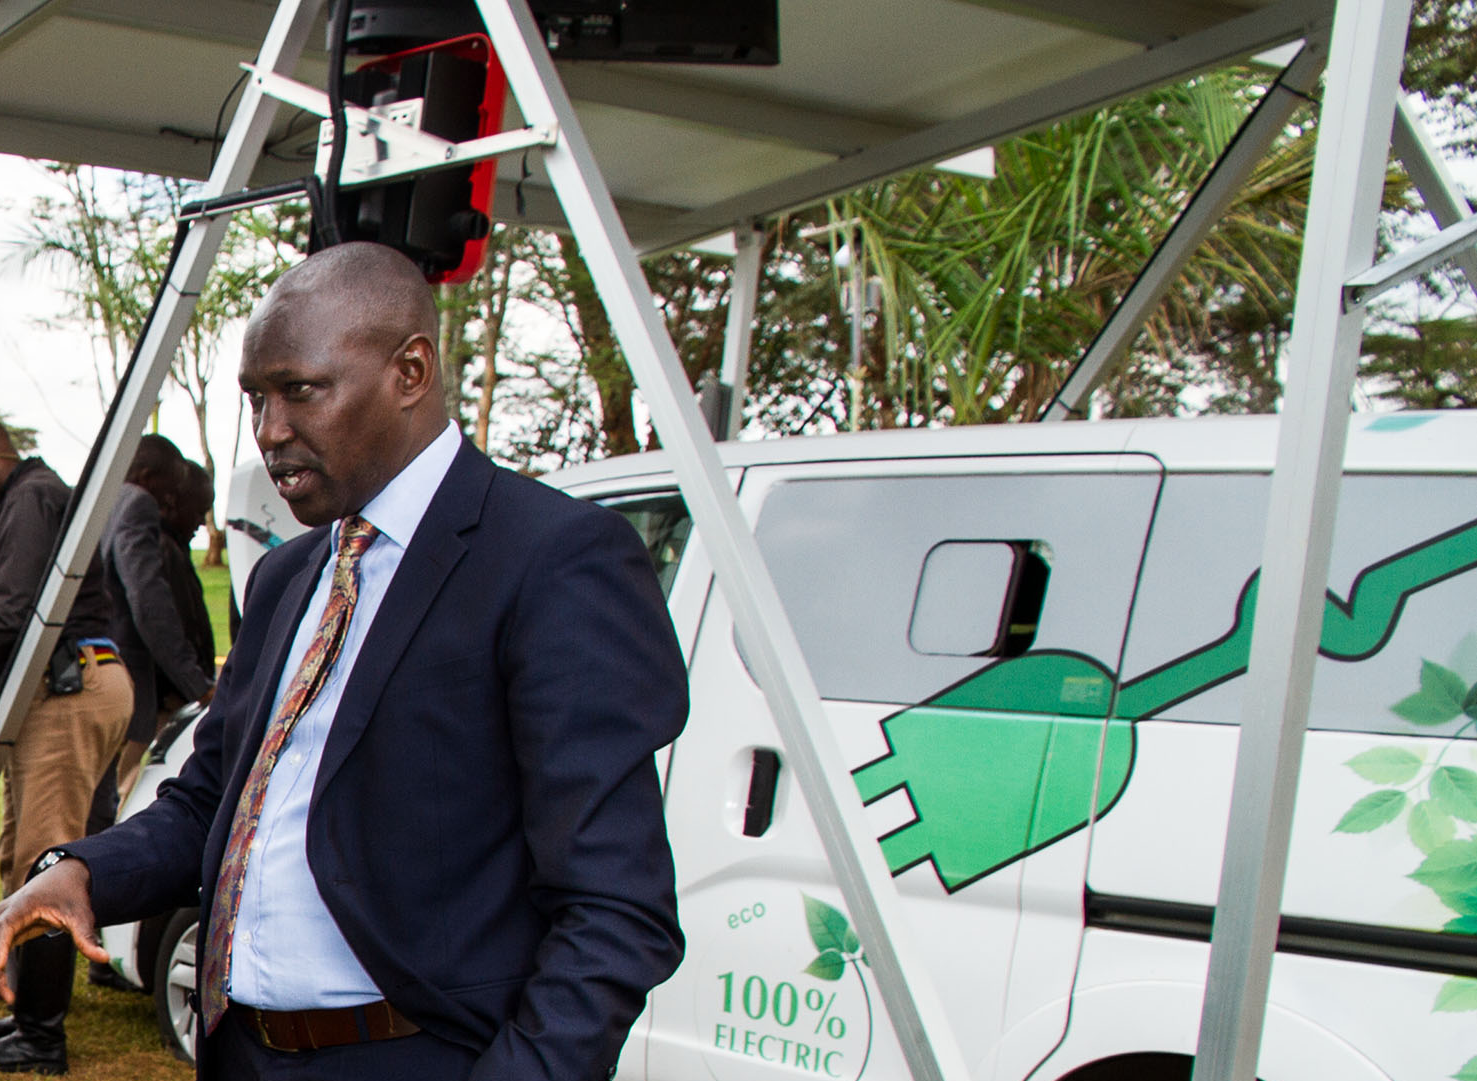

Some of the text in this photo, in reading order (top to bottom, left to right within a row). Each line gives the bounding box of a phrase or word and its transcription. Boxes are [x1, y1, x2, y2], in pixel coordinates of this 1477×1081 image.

[727, 902, 766, 929] eco
[717, 971, 846, 1039] 100%
[714, 1023, 845, 1078] ELECTRIC
